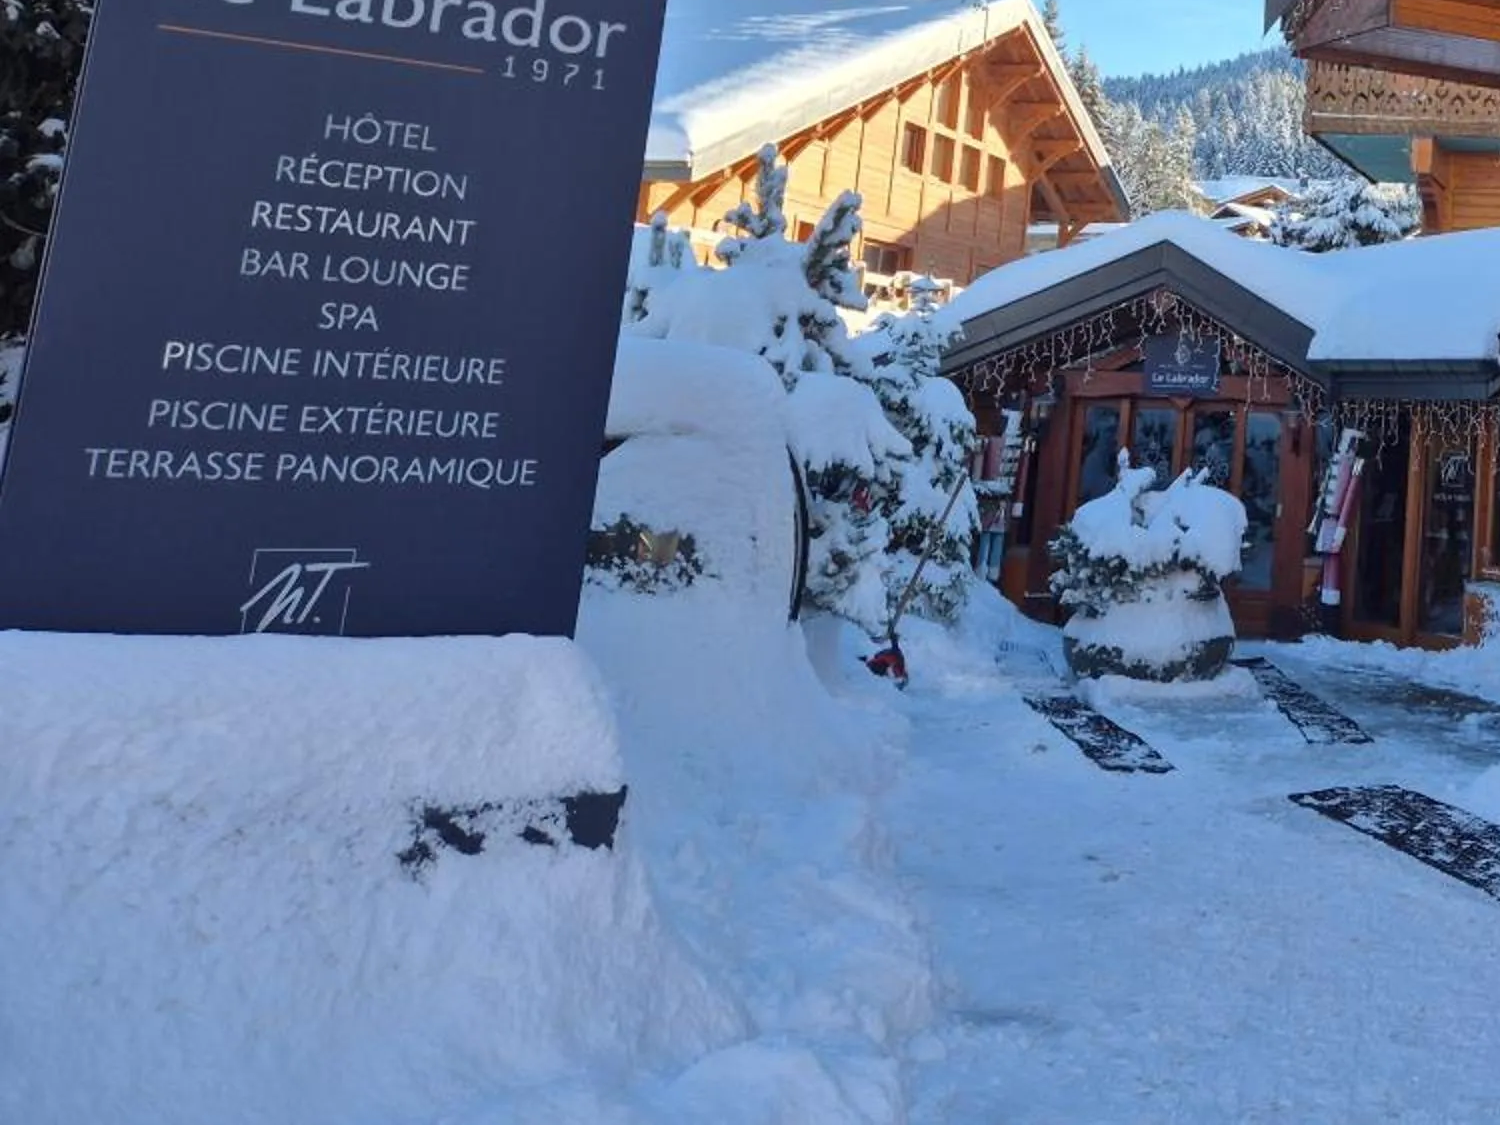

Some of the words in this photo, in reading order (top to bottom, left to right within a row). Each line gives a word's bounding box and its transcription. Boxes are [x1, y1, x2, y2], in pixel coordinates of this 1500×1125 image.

[500, 55, 607, 91] 1971
[324, 111, 438, 153] HÔTEL
[275, 152, 469, 202] RÉCEPTION
[251, 201, 477, 247] RESTAURANT
[240, 248, 310, 281] BAR
[322, 255, 471, 293] LOUNGE
[317, 301, 380, 333] SPA
[161, 340, 302, 377] PISCINE
[312, 346, 506, 386] INTÉRIEURE
[147, 399, 289, 434] PISCINE
[299, 400, 500, 440] EXTÉRIEURE
[84, 447, 265, 483] TERRASSE
[275, 454, 540, 490] PANORAMIQUE
